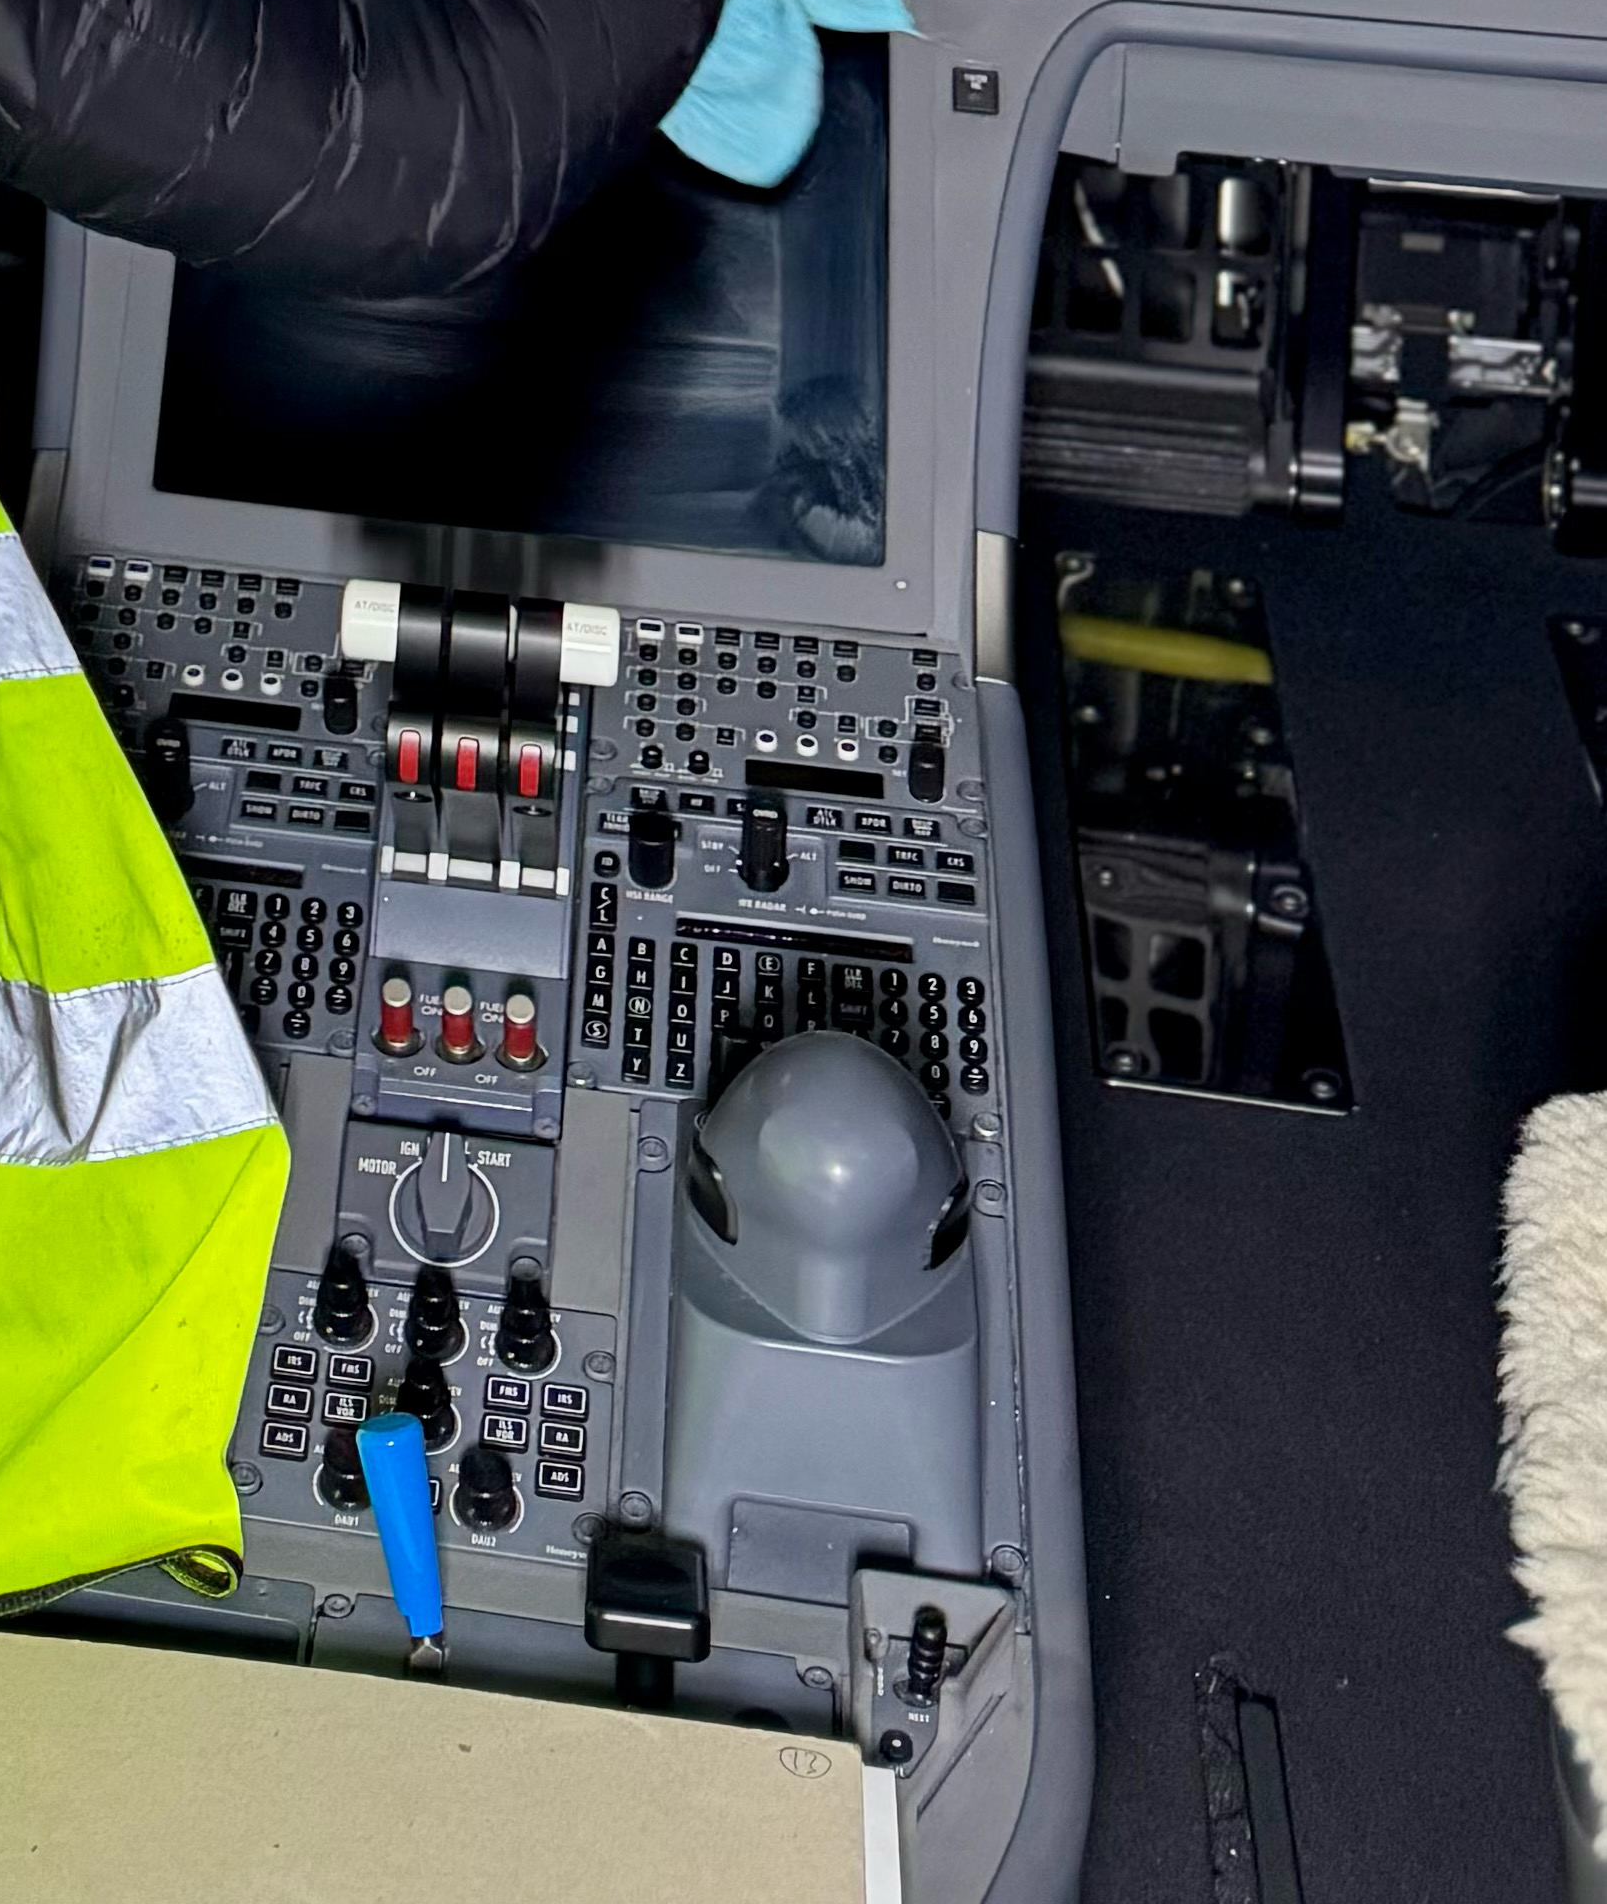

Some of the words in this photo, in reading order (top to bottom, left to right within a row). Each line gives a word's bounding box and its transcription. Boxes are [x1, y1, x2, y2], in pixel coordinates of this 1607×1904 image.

[353, 599, 397, 614] AT/DISC
[565, 622, 608, 637] AT/DISC
[895, 850, 919, 863] TRFC
[843, 875, 873, 887] SHOW
[892, 881, 923, 893] DIRTO
[275, 897, 282, 912] 1
[309, 901, 320, 915] 2
[345, 905, 355, 920] 3
[268, 925, 277, 939] 4
[305, 929, 315, 943] 5
[341, 933, 351, 947] 6
[596, 937, 607, 951] A
[637, 942, 647, 956] B
[679, 947, 689, 961] C
[265, 953, 274, 966] 7
[721, 952, 733, 966] D
[338, 961, 349, 975] 9
[595, 965, 607, 979] G
[807, 961, 816, 975] F
[635, 970, 647, 984] H
[891, 972, 897, 987] 1
[927, 977, 938, 991] 2
[722, 981, 731, 995] J
[764, 985, 775, 999] K
[965, 981, 977, 995] 3
[592, 993, 605, 1009] M
[634, 999, 646, 1012] N
[889, 1001, 899, 1015] 4
[420, 1005, 443, 1017] ON
[481, 1012, 505, 1024] ON
[676, 1004, 689, 1018] O
[929, 1005, 939, 1020] 5
[968, 1009, 979, 1024] 6
[633, 1027, 643, 1042] T
[677, 1033, 687, 1047] U
[891, 1029, 900, 1043] 7
[969, 1039, 979, 1053] 9
[413, 1065, 437, 1077] OFF
[631, 1057, 642, 1072] Y
[675, 1063, 686, 1077] Z
[474, 1073, 499, 1085] OFF
[399, 1140, 421, 1157] IGN
[357, 1157, 397, 1175] MOTOR
[477, 1150, 512, 1169] START
[293, 1331, 311, 1342] OFF
[476, 1355, 495, 1367] OFF
[341, 1363, 361, 1375] FMS
[499, 1385, 519, 1397] FMS
[282, 1393, 297, 1405] RA
[557, 1393, 573, 1405] IRS
[274, 1431, 295, 1444] ADS
[555, 1431, 569, 1443] RA
[550, 1471, 570, 1483] ADS
